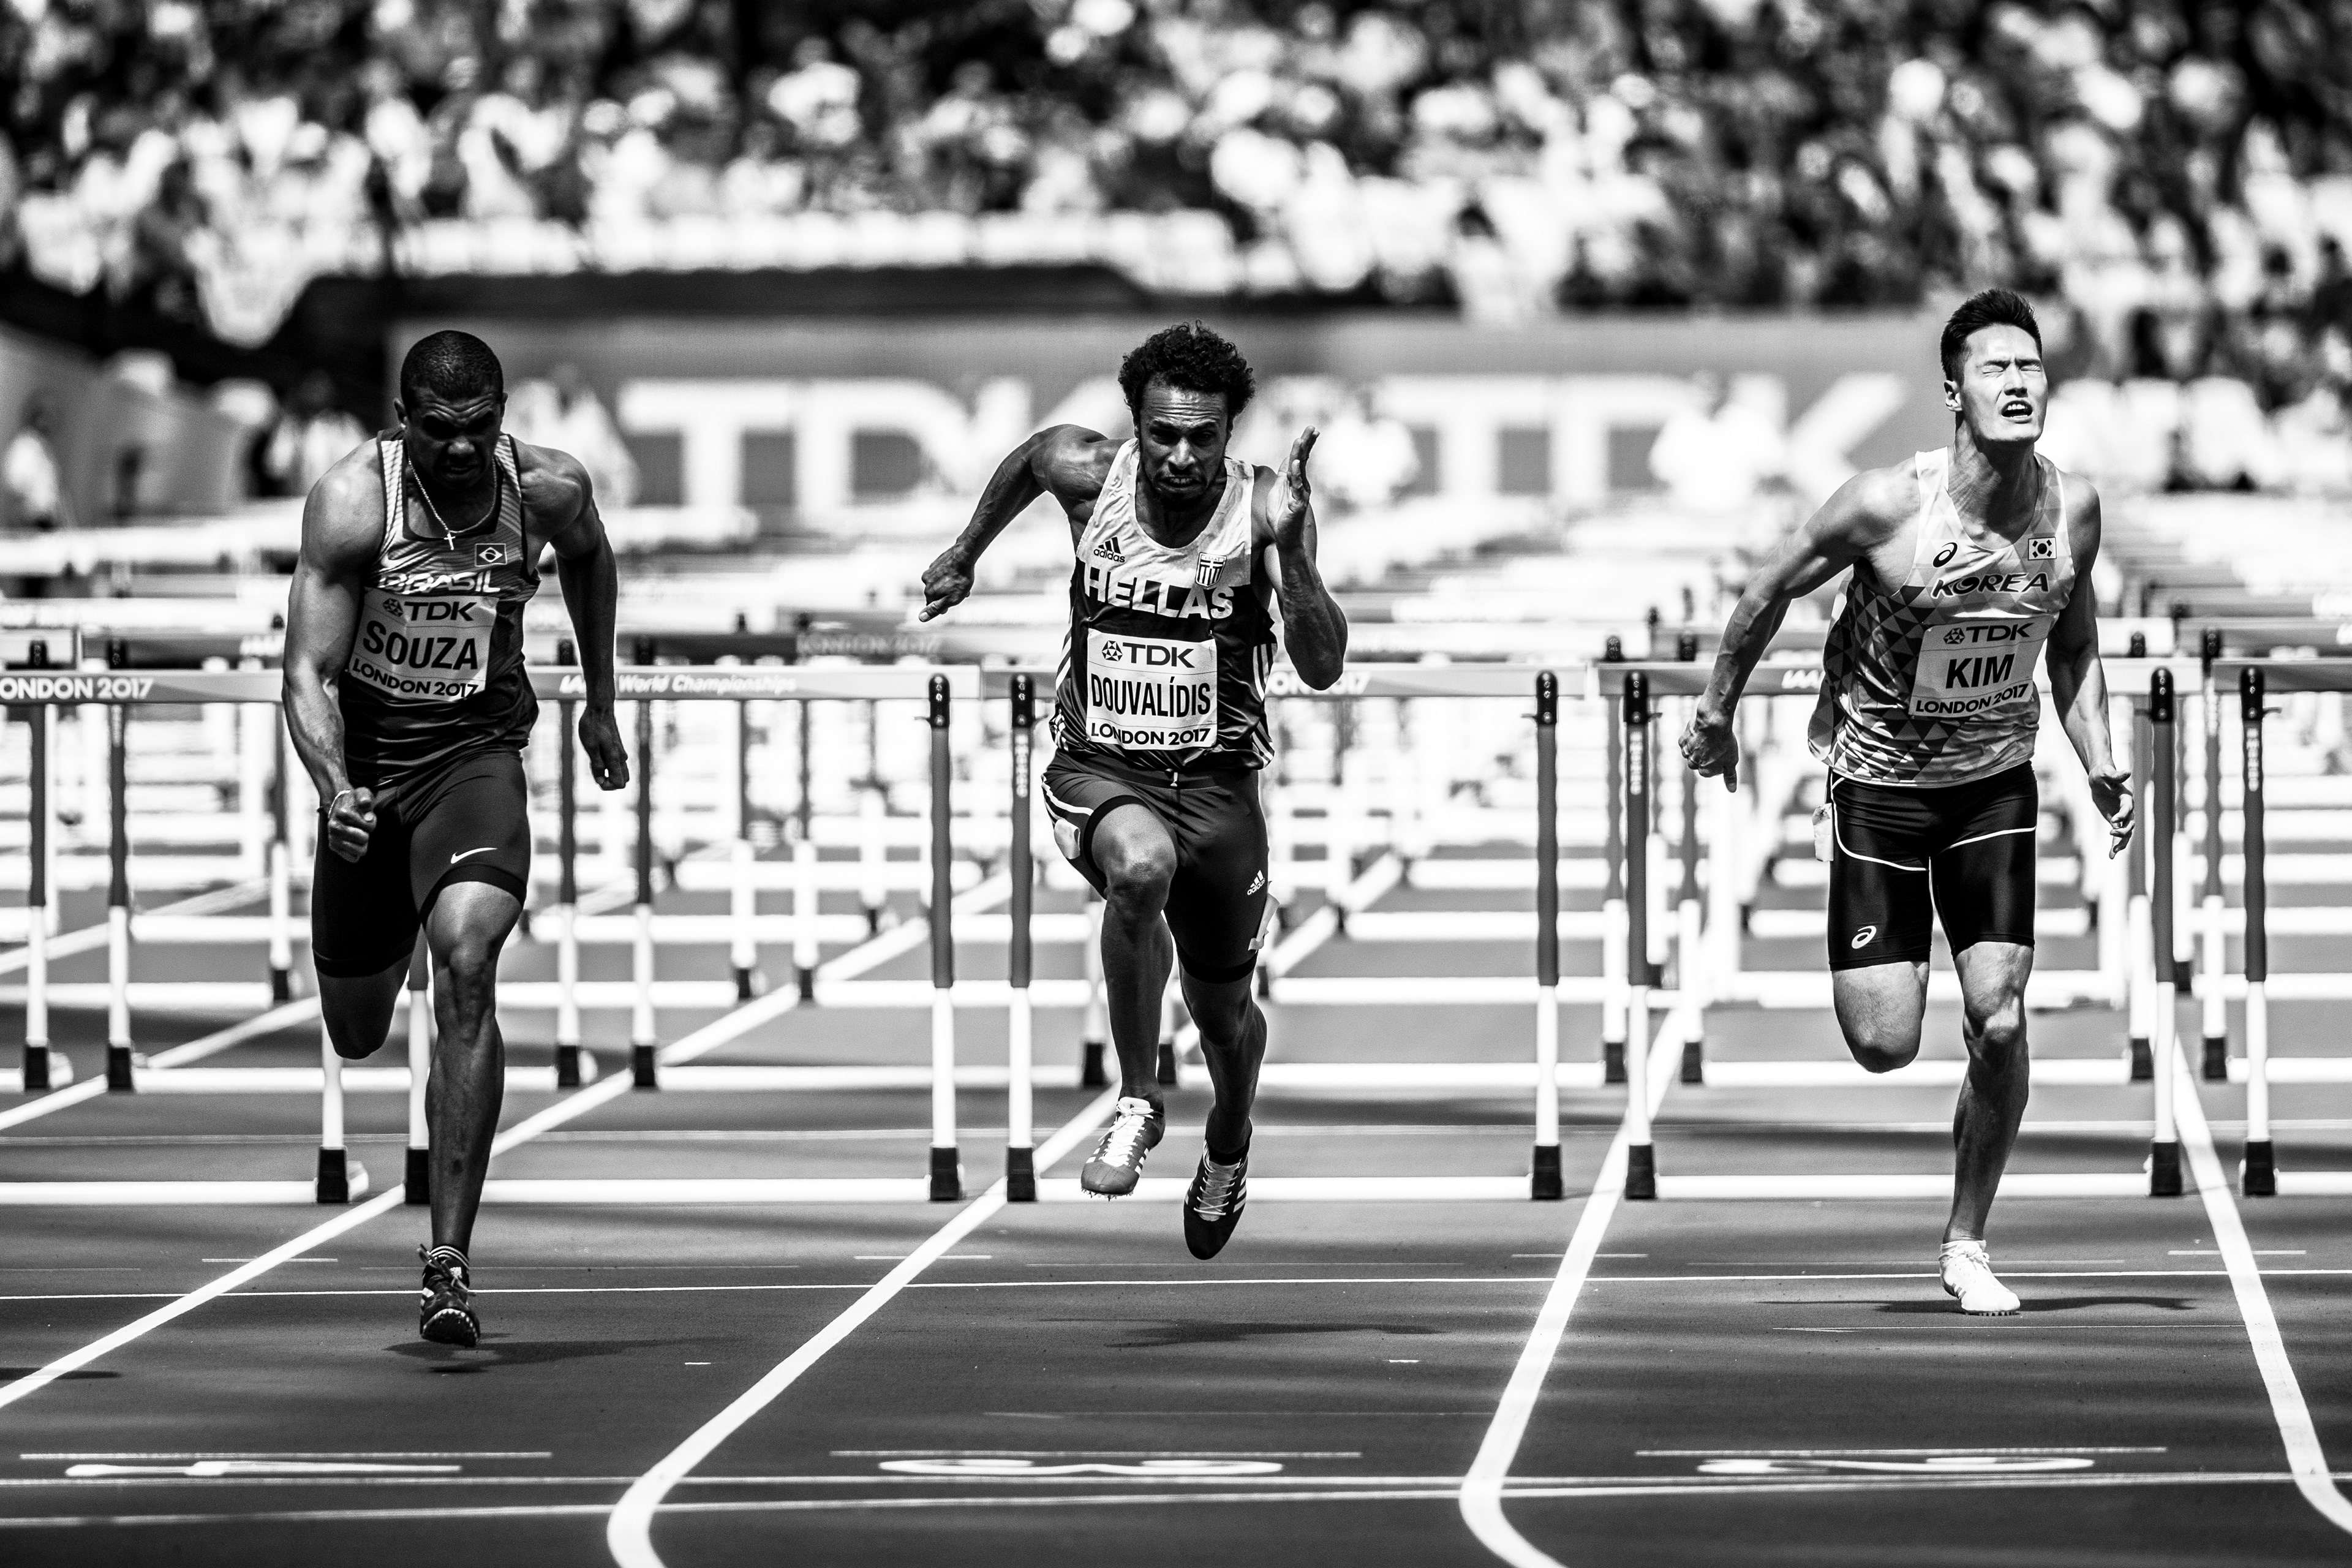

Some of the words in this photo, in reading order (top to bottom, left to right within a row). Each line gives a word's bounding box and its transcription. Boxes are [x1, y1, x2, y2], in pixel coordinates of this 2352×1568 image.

[1093, 547, 1125, 563] adidas
[378, 570, 500, 595] BRASIL
[1084, 565, 1234, 620] HELLAS
[1931, 572, 2049, 598] KOREA
[404, 601, 477, 622] TDK
[363, 620, 478, 670] SOUZA
[1966, 623, 2034, 643] TDK
[1123, 642, 1195, 668] TDK
[352, 658, 431, 694] LONDON
[433, 682, 479, 698] 2017
[1945, 653, 2015, 689] KIM
[0, 677, 93, 699] ONDON
[97, 677, 154, 699] 2017
[619, 674, 669, 693] World
[672, 674, 796, 696] Championships
[1091, 673, 1211, 718] DOUVALÍDIS
[1915, 696, 1992, 714] LONDON
[1992, 683, 2029, 706] 2017
[1091, 723, 1165, 745] LONDON
[1169, 728, 1211, 745] 2017
[1247, 878, 1265, 895] adidas
